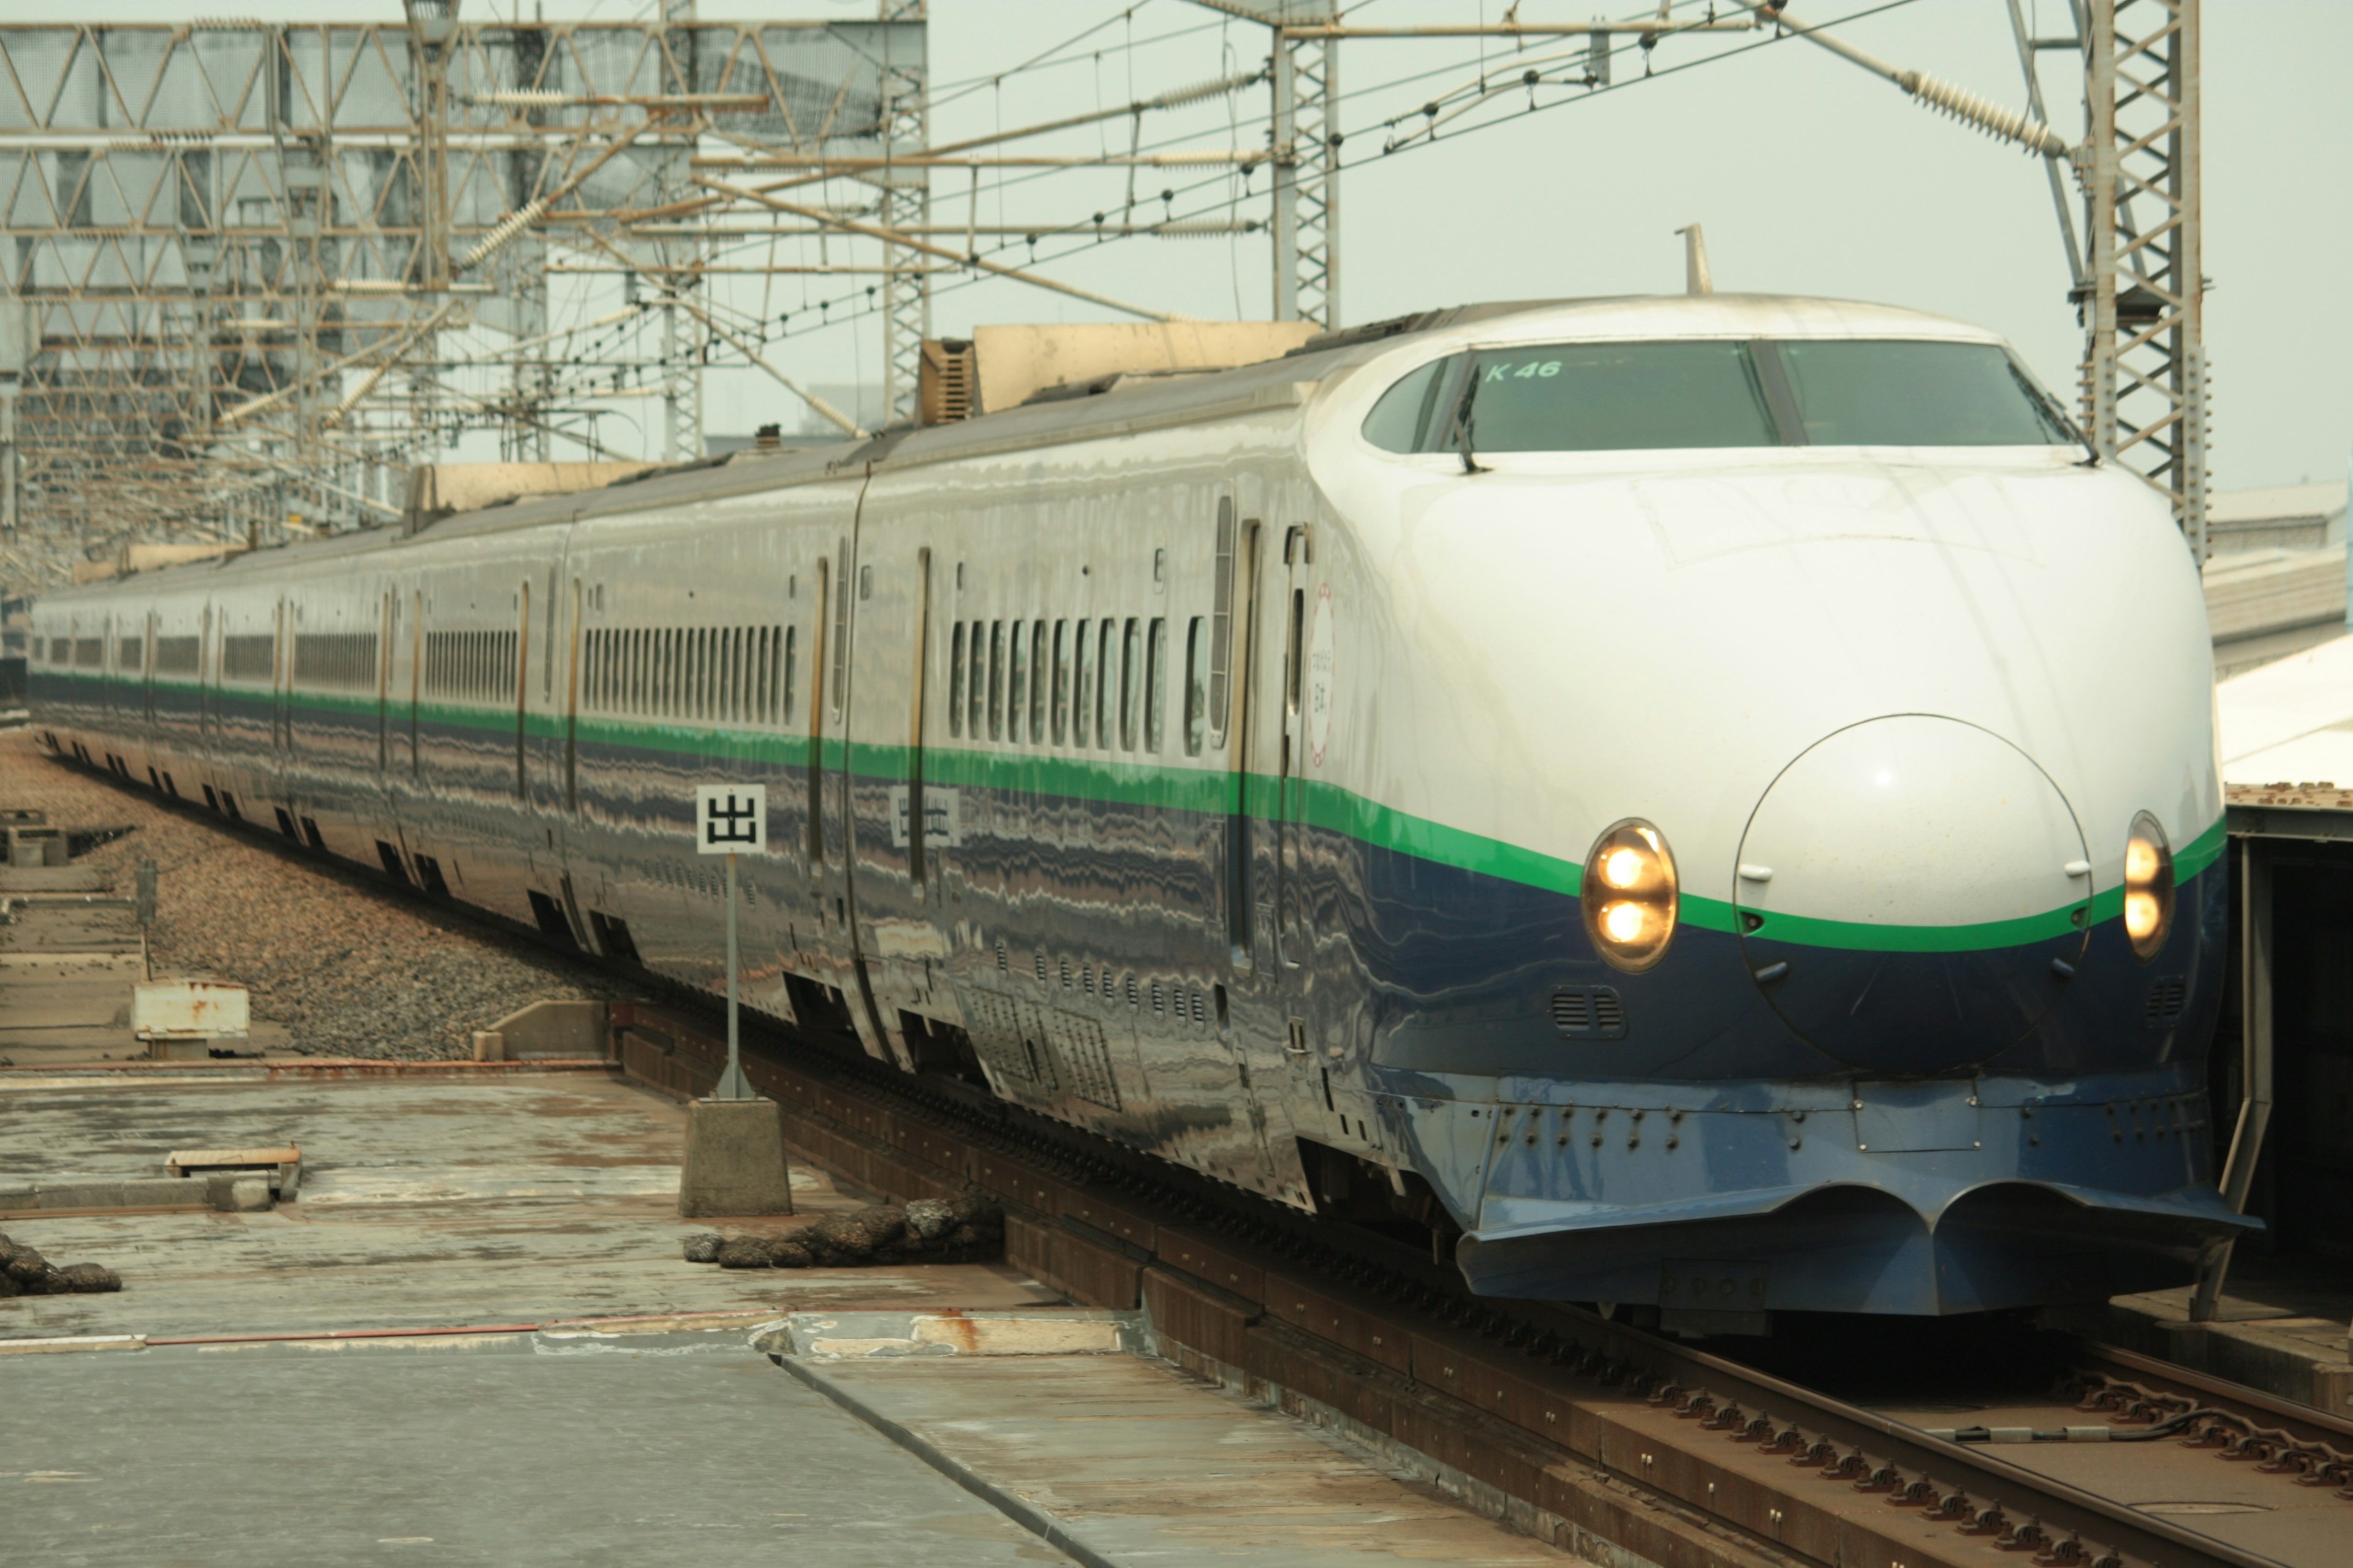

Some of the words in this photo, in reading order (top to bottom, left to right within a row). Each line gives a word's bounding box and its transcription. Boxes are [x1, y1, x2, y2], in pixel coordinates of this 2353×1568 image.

[1485, 363, 1512, 382] K
[1514, 361, 1562, 378] 46
[707, 795, 756, 844] 出
